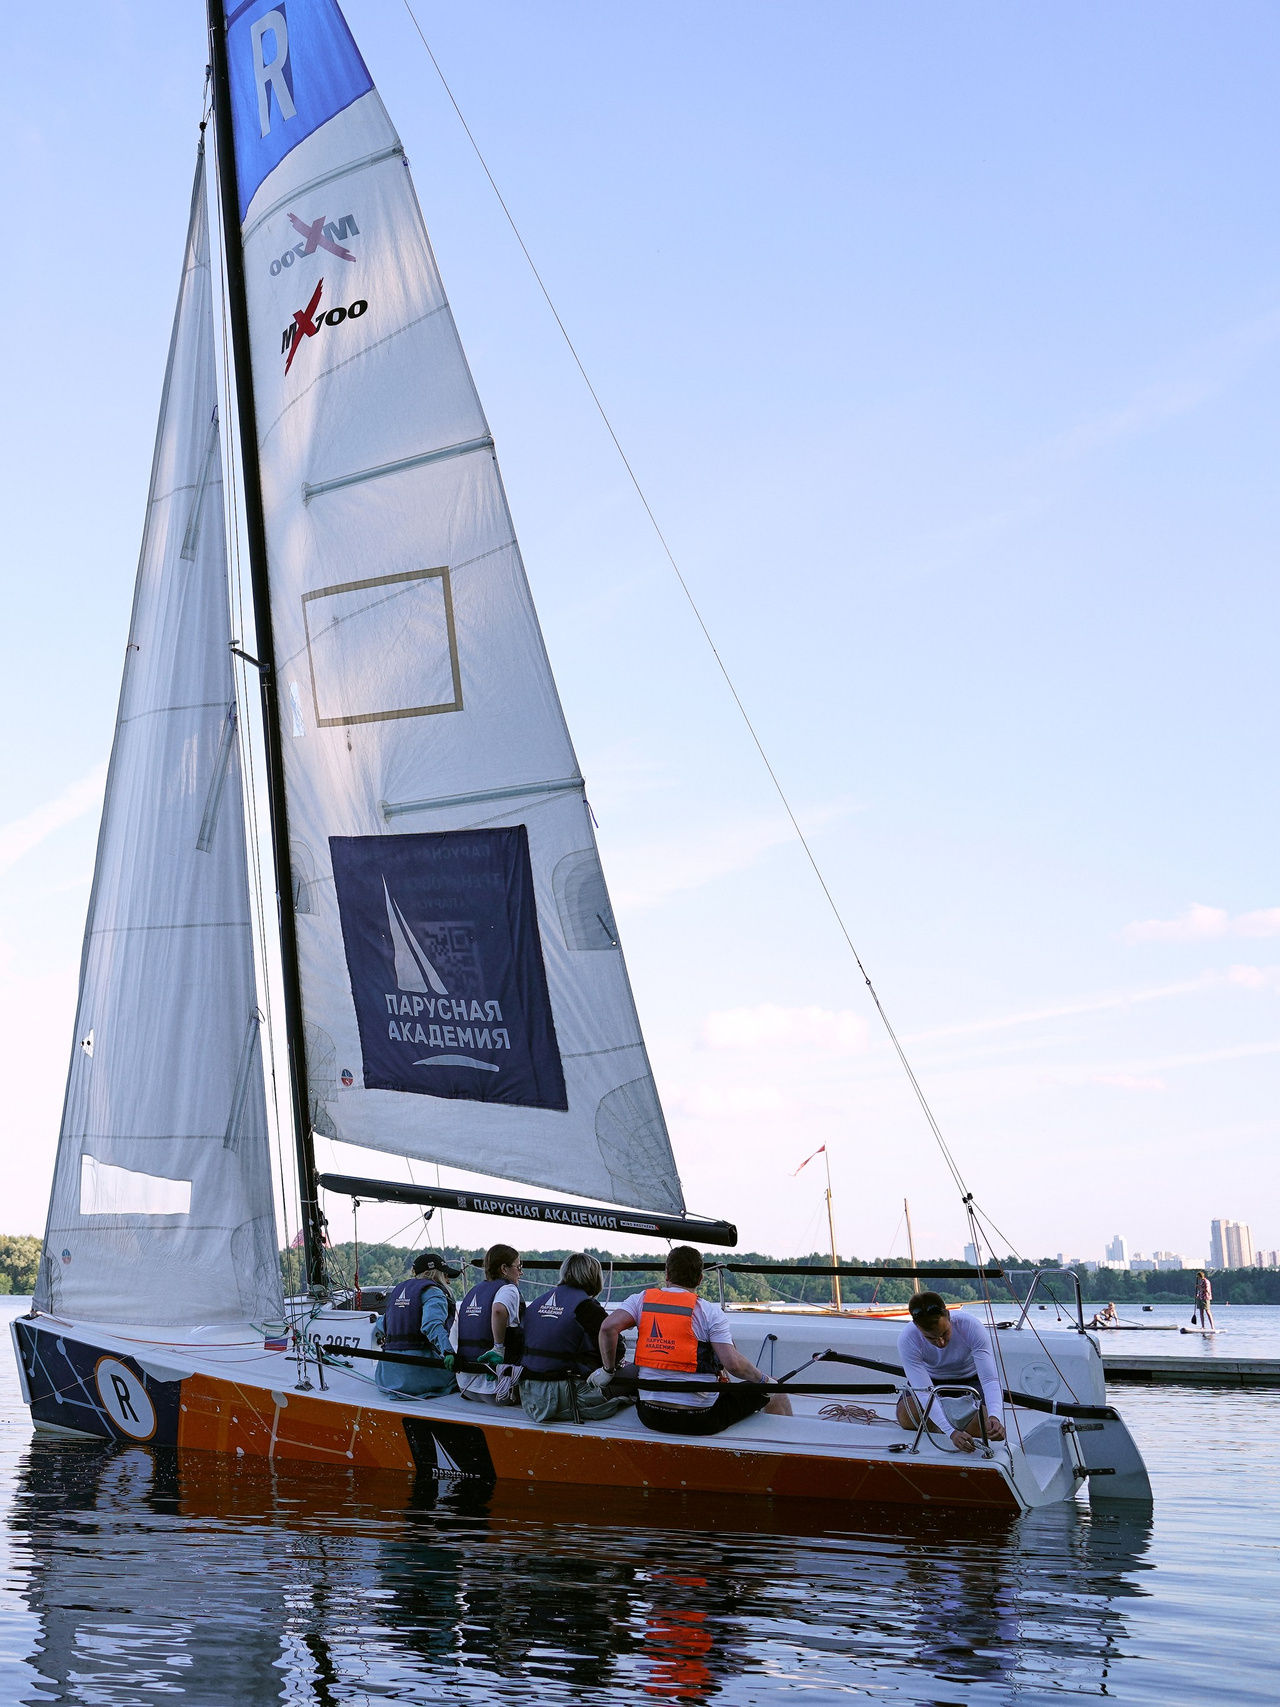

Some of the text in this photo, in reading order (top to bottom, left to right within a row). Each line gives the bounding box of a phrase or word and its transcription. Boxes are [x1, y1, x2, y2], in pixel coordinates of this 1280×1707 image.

[250, 9, 297, 139] R
[385, 993, 503, 1022] ПАРУСНАЯ
[388, 1020, 511, 1049] АКАДЕМИЯ
[473, 1198, 618, 1229] ПАРУСНАЯ АКАДЕМИЯ
[110, 1373, 140, 1423] R
